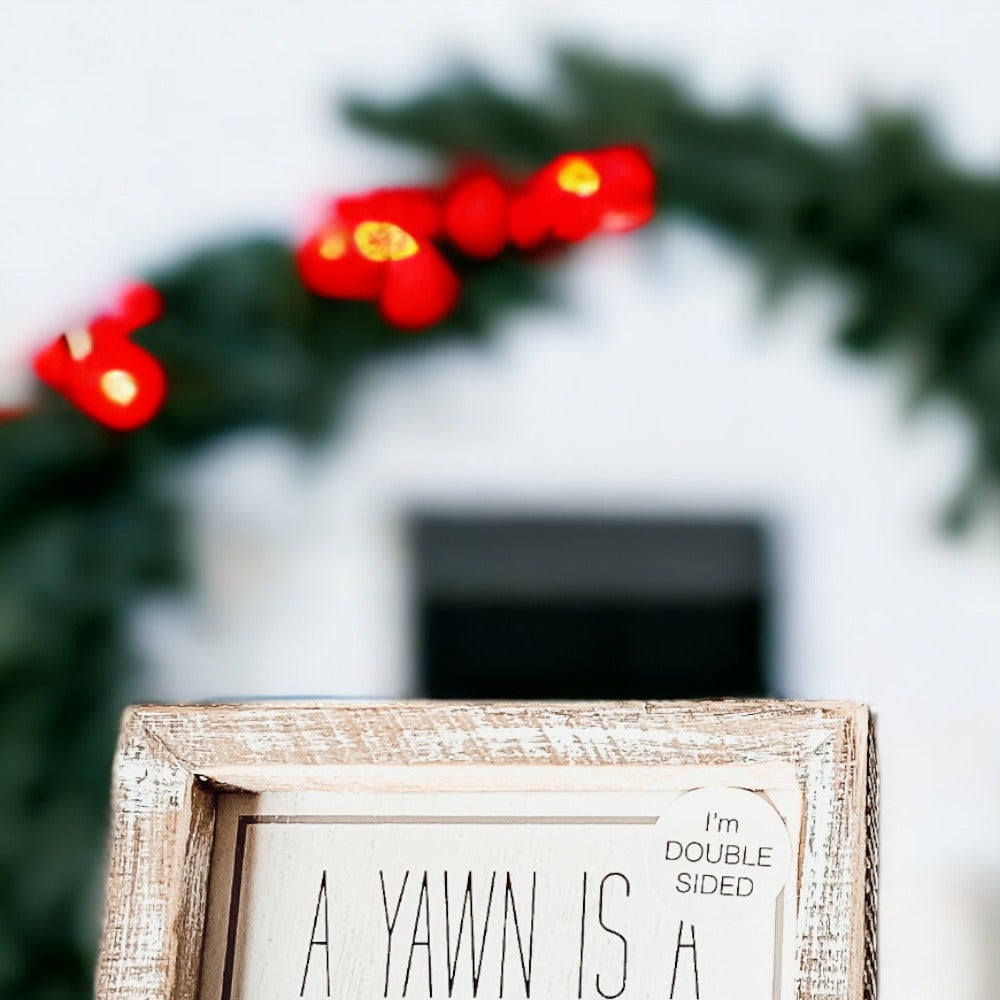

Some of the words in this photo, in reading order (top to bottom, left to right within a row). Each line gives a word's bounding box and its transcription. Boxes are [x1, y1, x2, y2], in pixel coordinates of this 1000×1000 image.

[704, 811, 740, 834] I'm
[663, 839, 774, 869] DOUBLE
[674, 873, 755, 898] SIDED
[300, 870, 331, 998] A
[379, 870, 537, 999] YAWN
[578, 871, 631, 1000] IS
